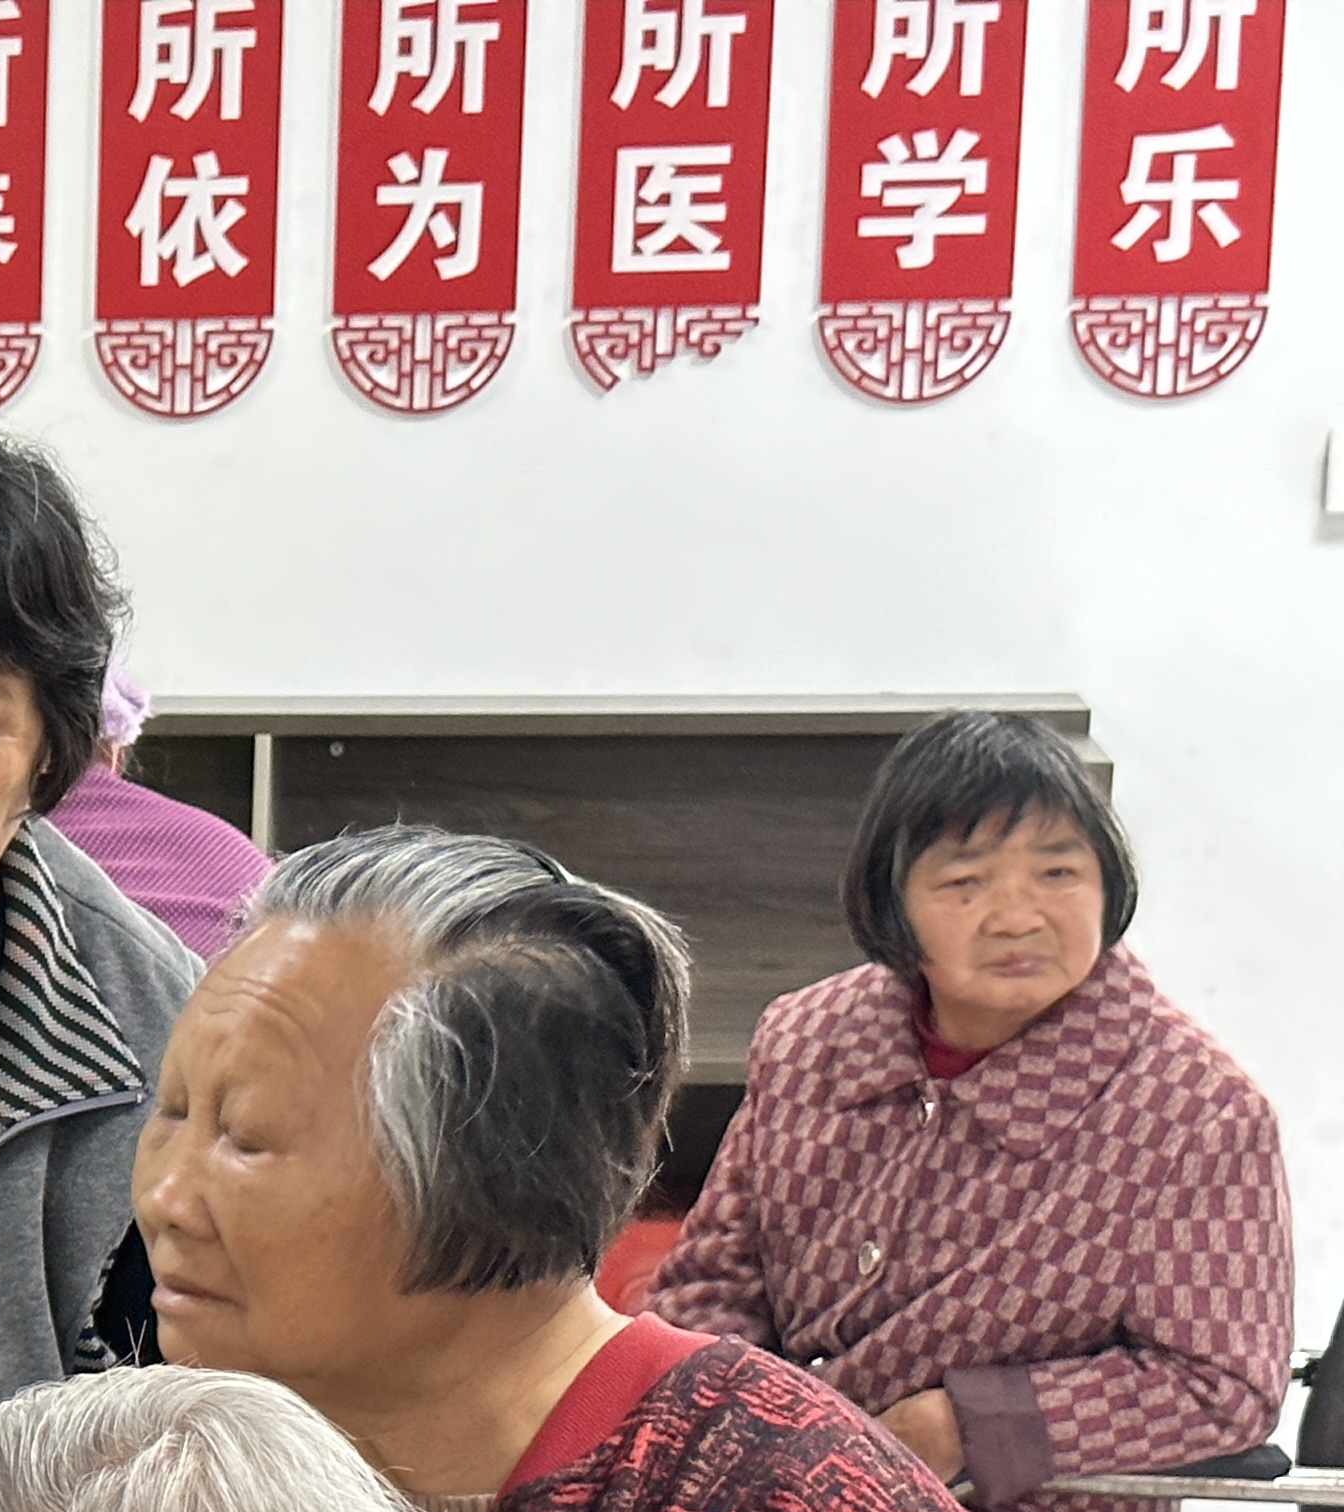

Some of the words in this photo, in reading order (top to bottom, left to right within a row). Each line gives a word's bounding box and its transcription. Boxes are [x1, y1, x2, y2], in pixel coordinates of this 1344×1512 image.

[123, 0, 257, 288] 所依
[367, 0, 501, 282] 所为
[610, 0, 747, 274] 所医
[857, 0, 1002, 270] 所学
[1110, 0, 1257, 263] 所乐
